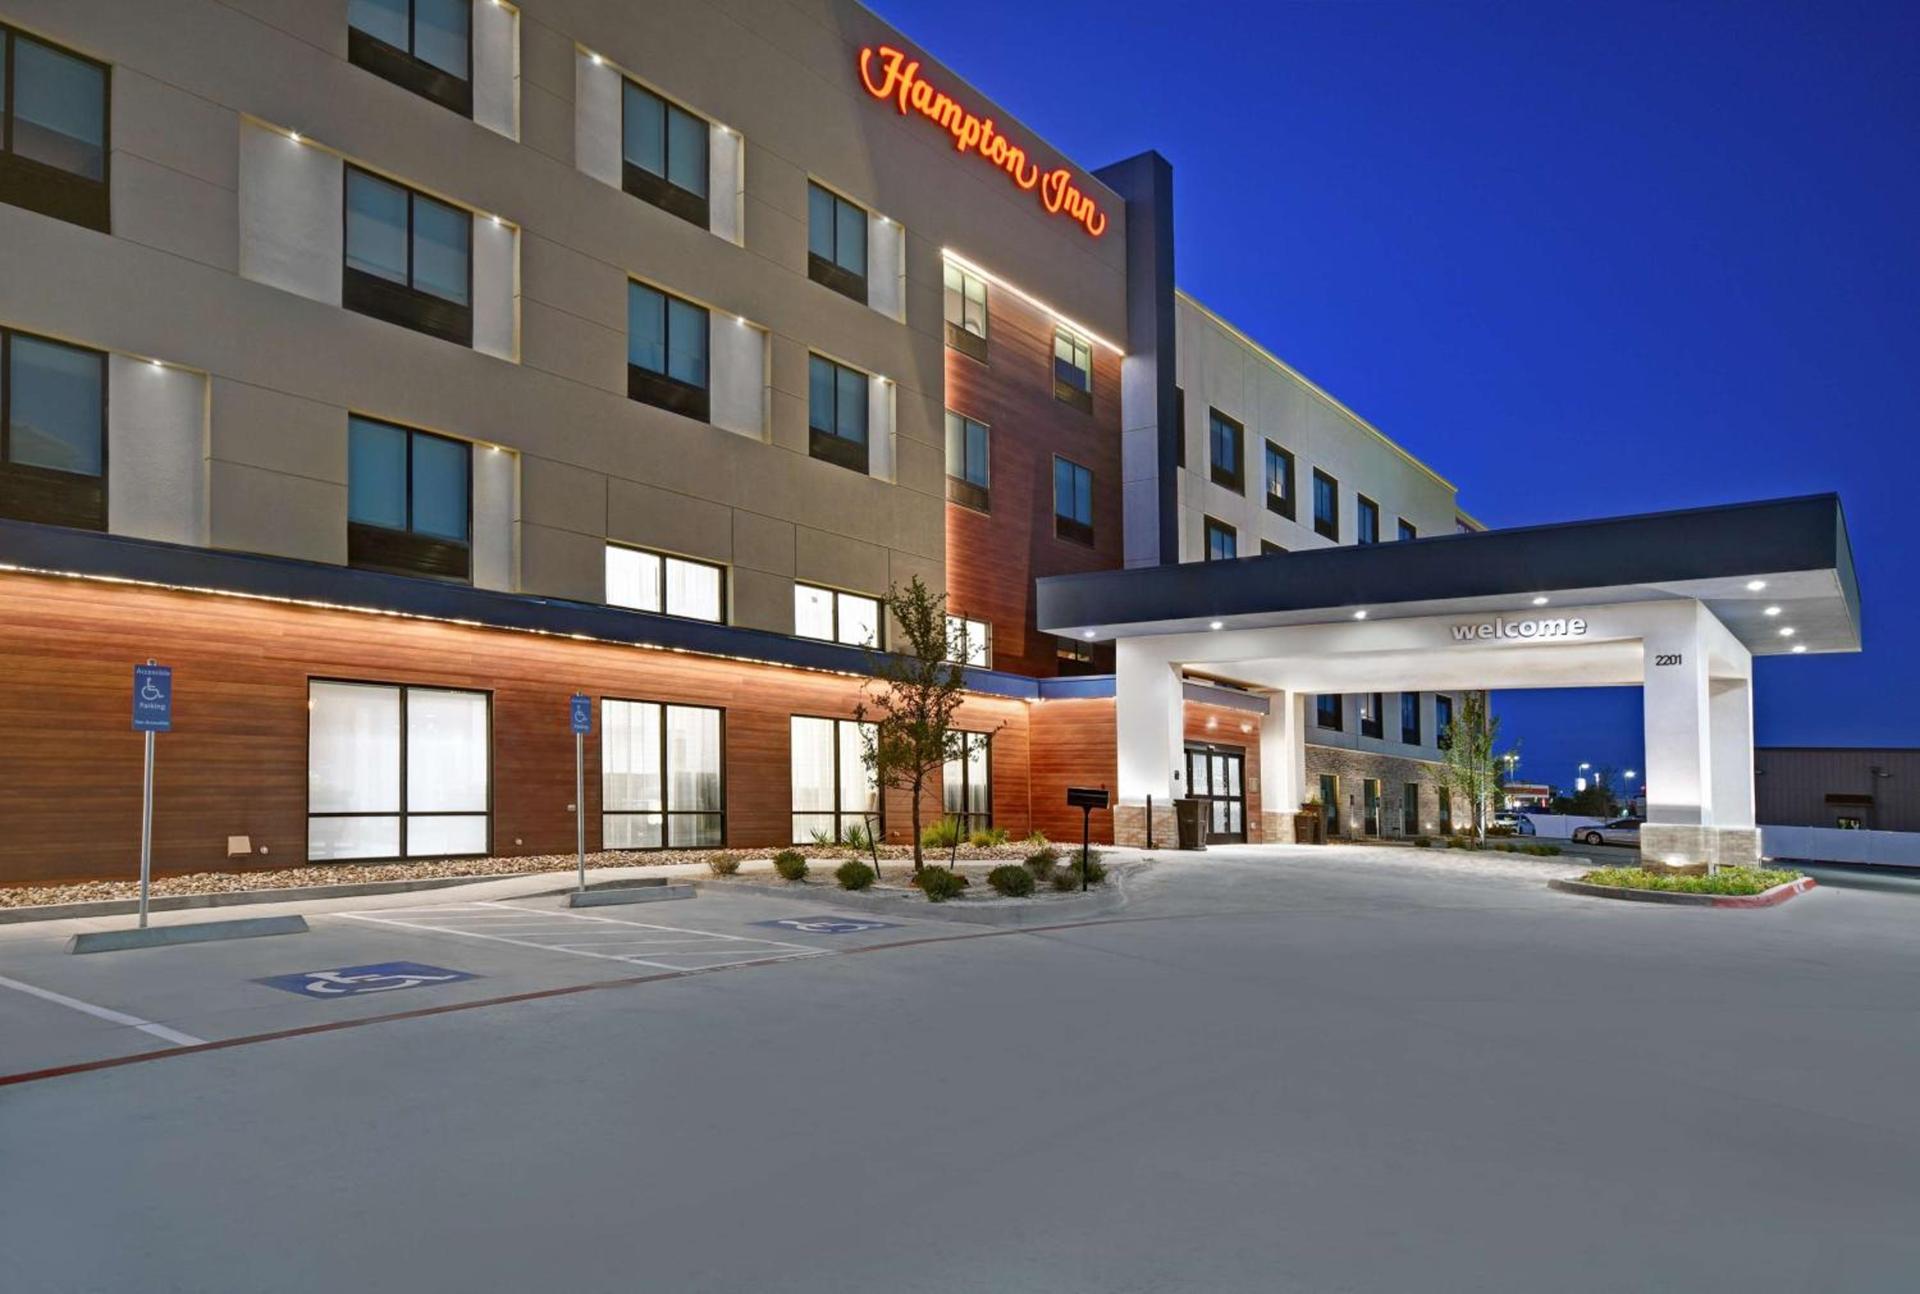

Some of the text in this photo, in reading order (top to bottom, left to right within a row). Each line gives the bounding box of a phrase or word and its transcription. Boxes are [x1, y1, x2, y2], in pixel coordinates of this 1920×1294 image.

[860, 46, 1106, 236] Hampton Inn
[1452, 616, 1587, 640] welcome
[1655, 654, 1682, 666] 2201
[140, 702, 166, 711] Parking
